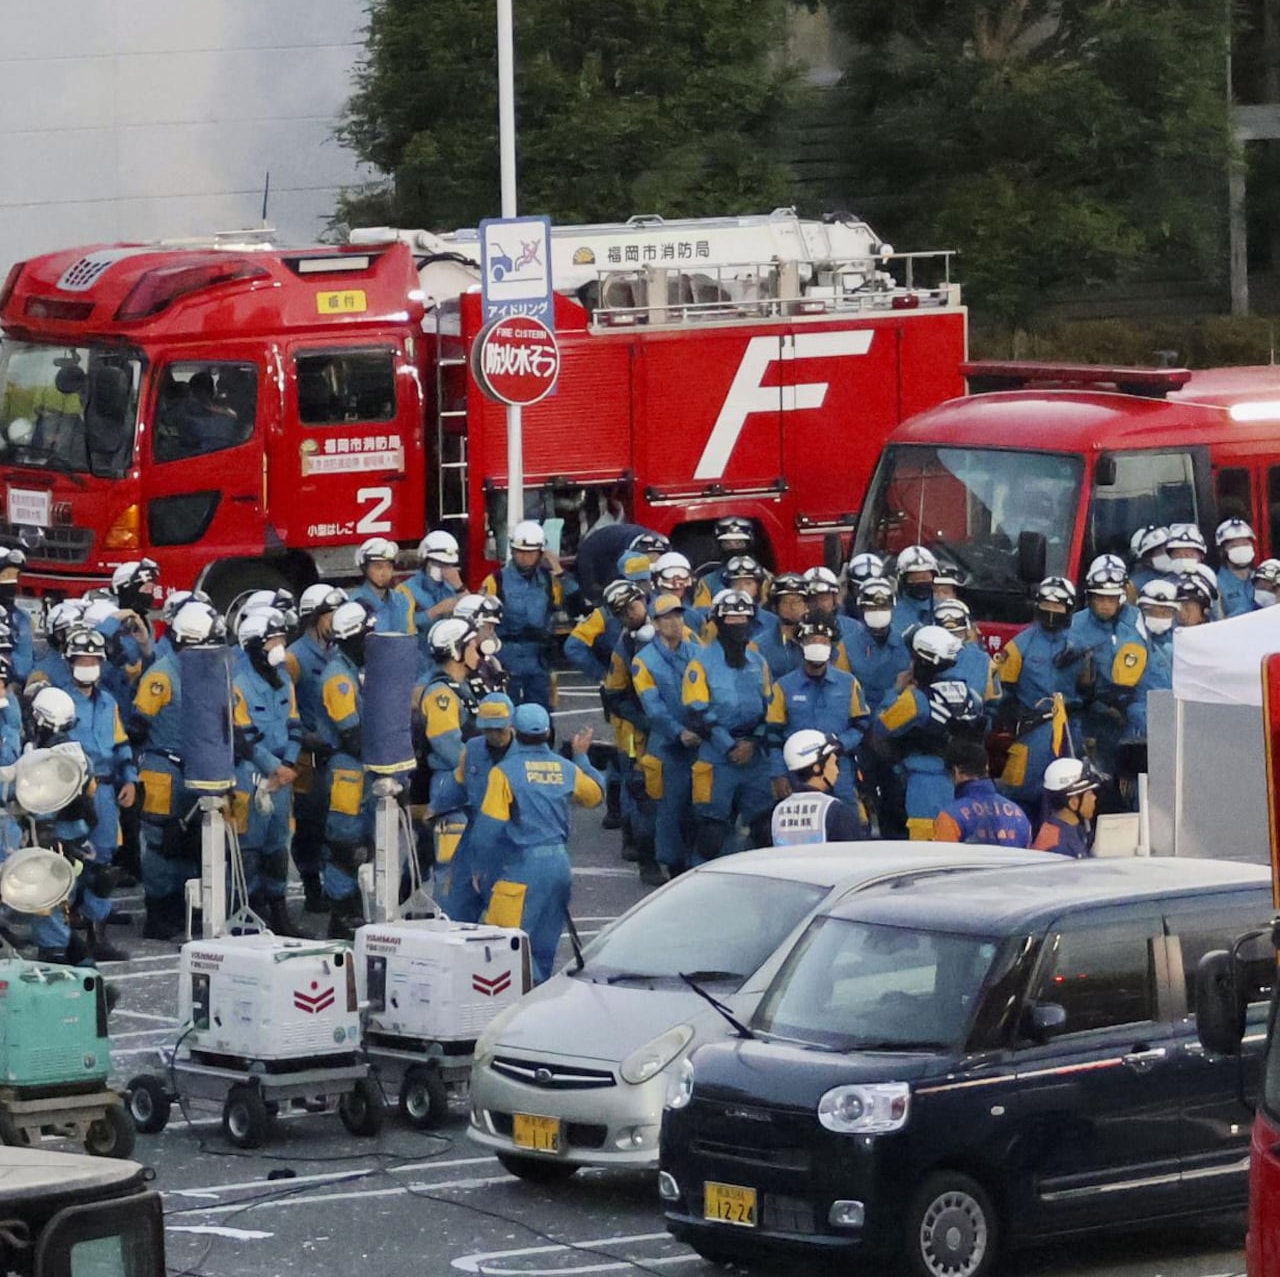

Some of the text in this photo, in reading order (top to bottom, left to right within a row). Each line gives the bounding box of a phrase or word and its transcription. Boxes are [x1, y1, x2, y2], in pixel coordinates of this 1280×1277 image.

[607, 240, 710, 263] 福岡市消防局
[487, 301, 548, 319] アイドリング
[496, 327, 513, 338] FIRE
[486, 342, 556, 378] 防火水そう
[693, 329, 875, 481] F
[324, 434, 401, 453] 福岡市消防局
[307, 486, 392, 538] 小型はしご 2
[527, 771, 565, 784] POLICE
